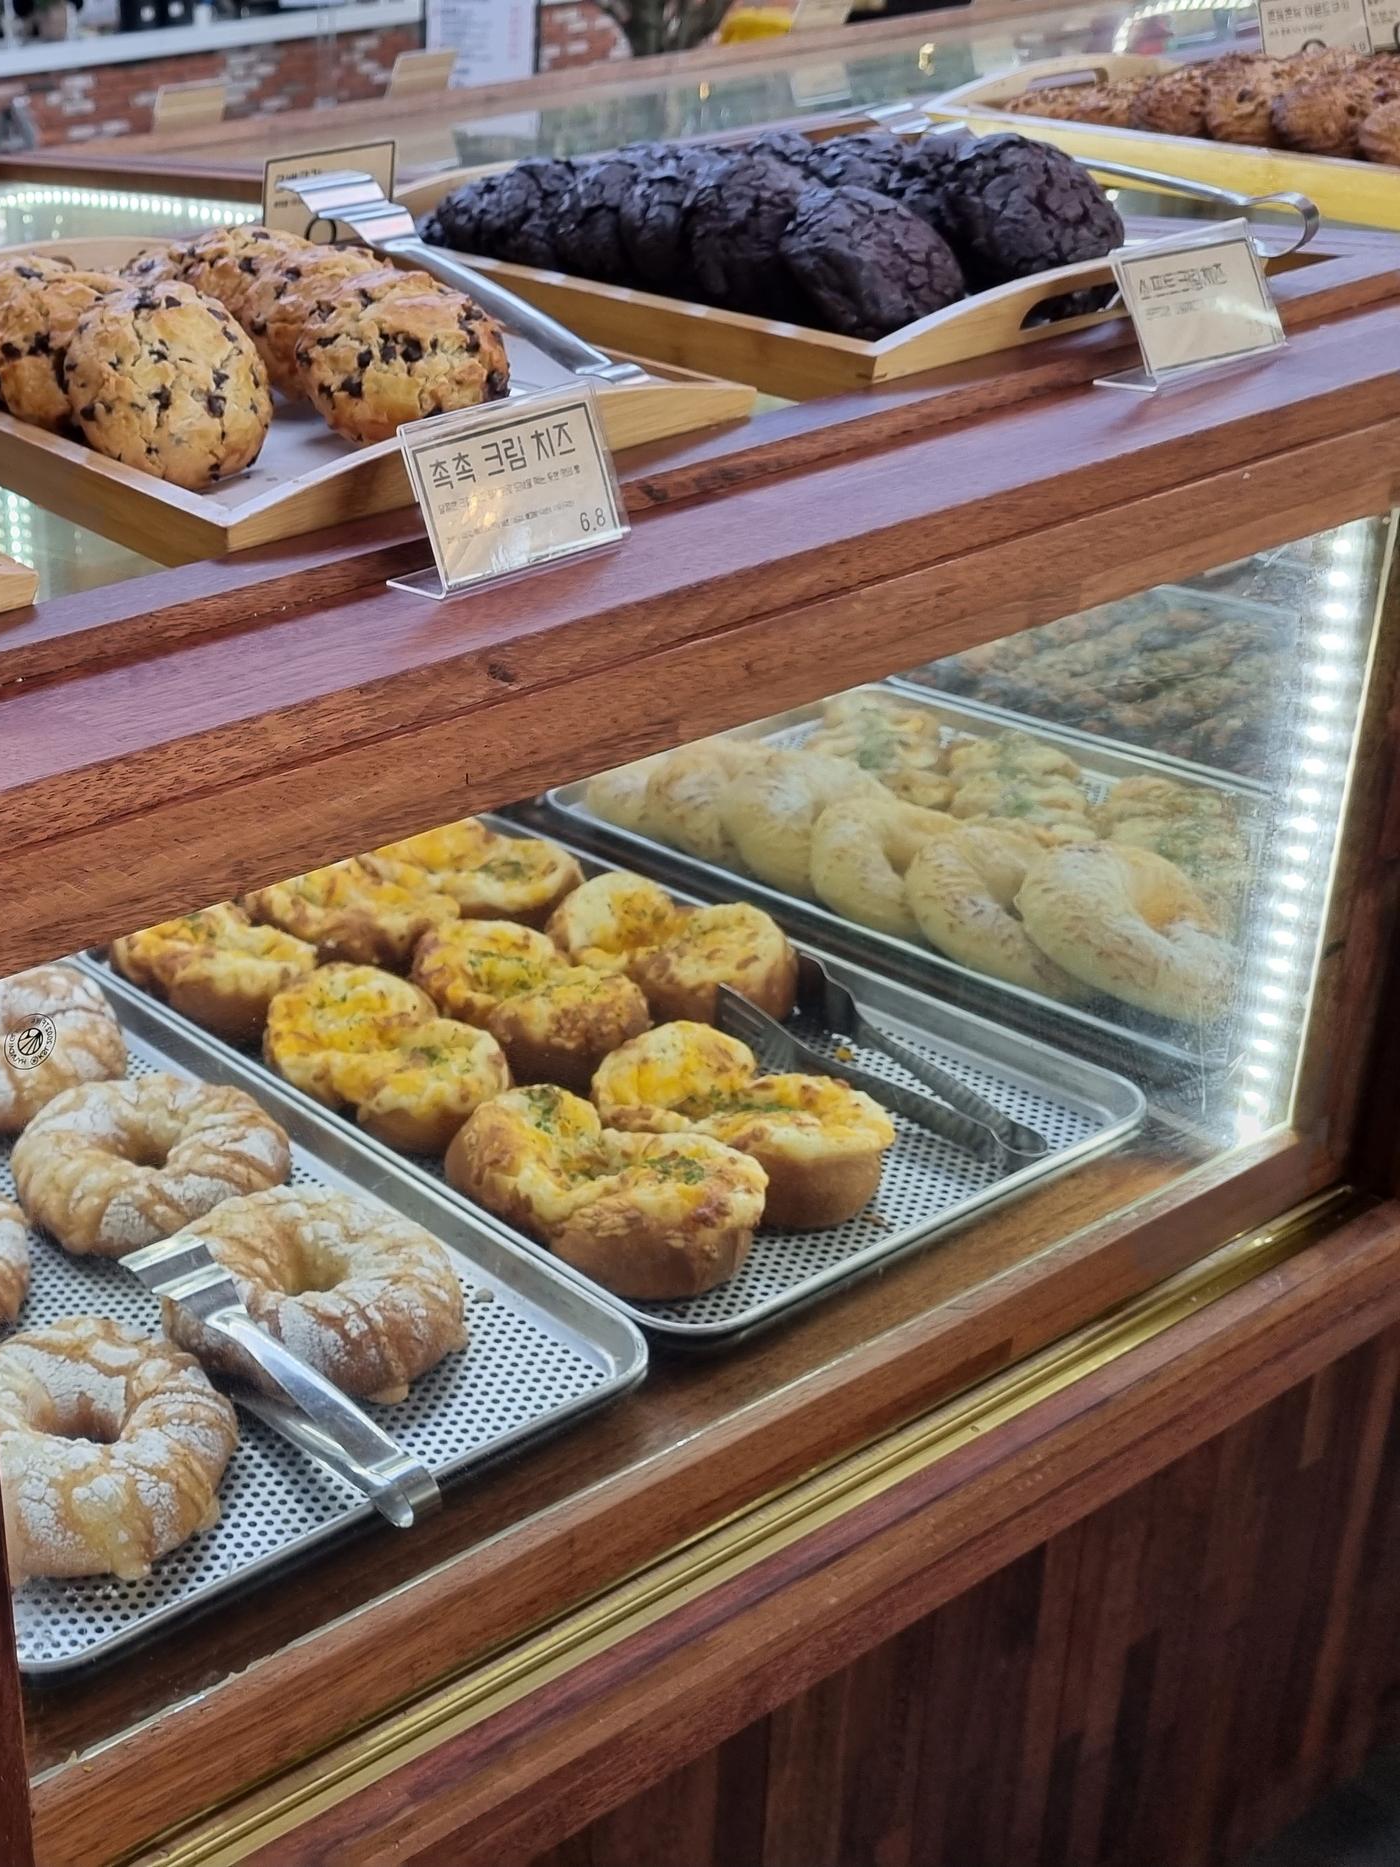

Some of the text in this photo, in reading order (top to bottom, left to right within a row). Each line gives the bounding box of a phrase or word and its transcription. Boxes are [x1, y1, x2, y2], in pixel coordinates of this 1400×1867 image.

[429, 421, 577, 489] 촉촉 크림 치즈
[579, 507, 607, 533] 6.8
